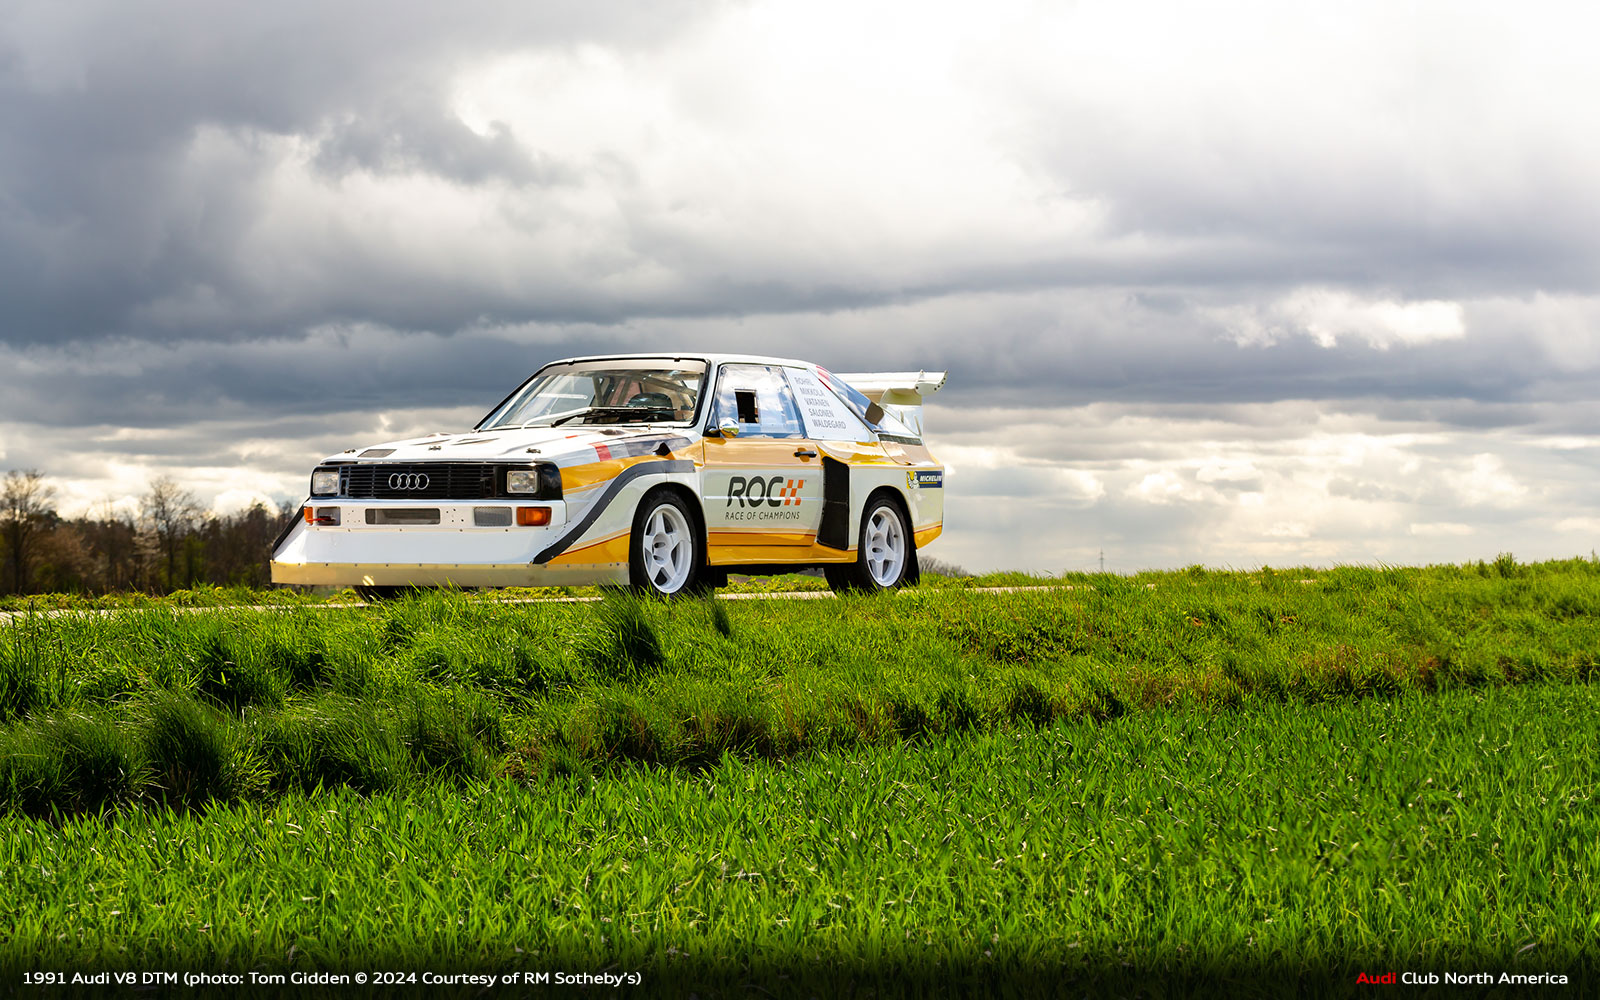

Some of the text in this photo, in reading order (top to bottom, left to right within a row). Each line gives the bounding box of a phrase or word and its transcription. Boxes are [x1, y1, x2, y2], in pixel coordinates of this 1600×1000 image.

[799, 387, 825, 397] MIKKOLA
[804, 397, 830, 407] VATANEN
[808, 408, 834, 418] SALONEN
[812, 419, 847, 430] WALDEGARD
[726, 475, 784, 508] ROC
[725, 511, 800, 520] RACE OF CHAMPIONS
